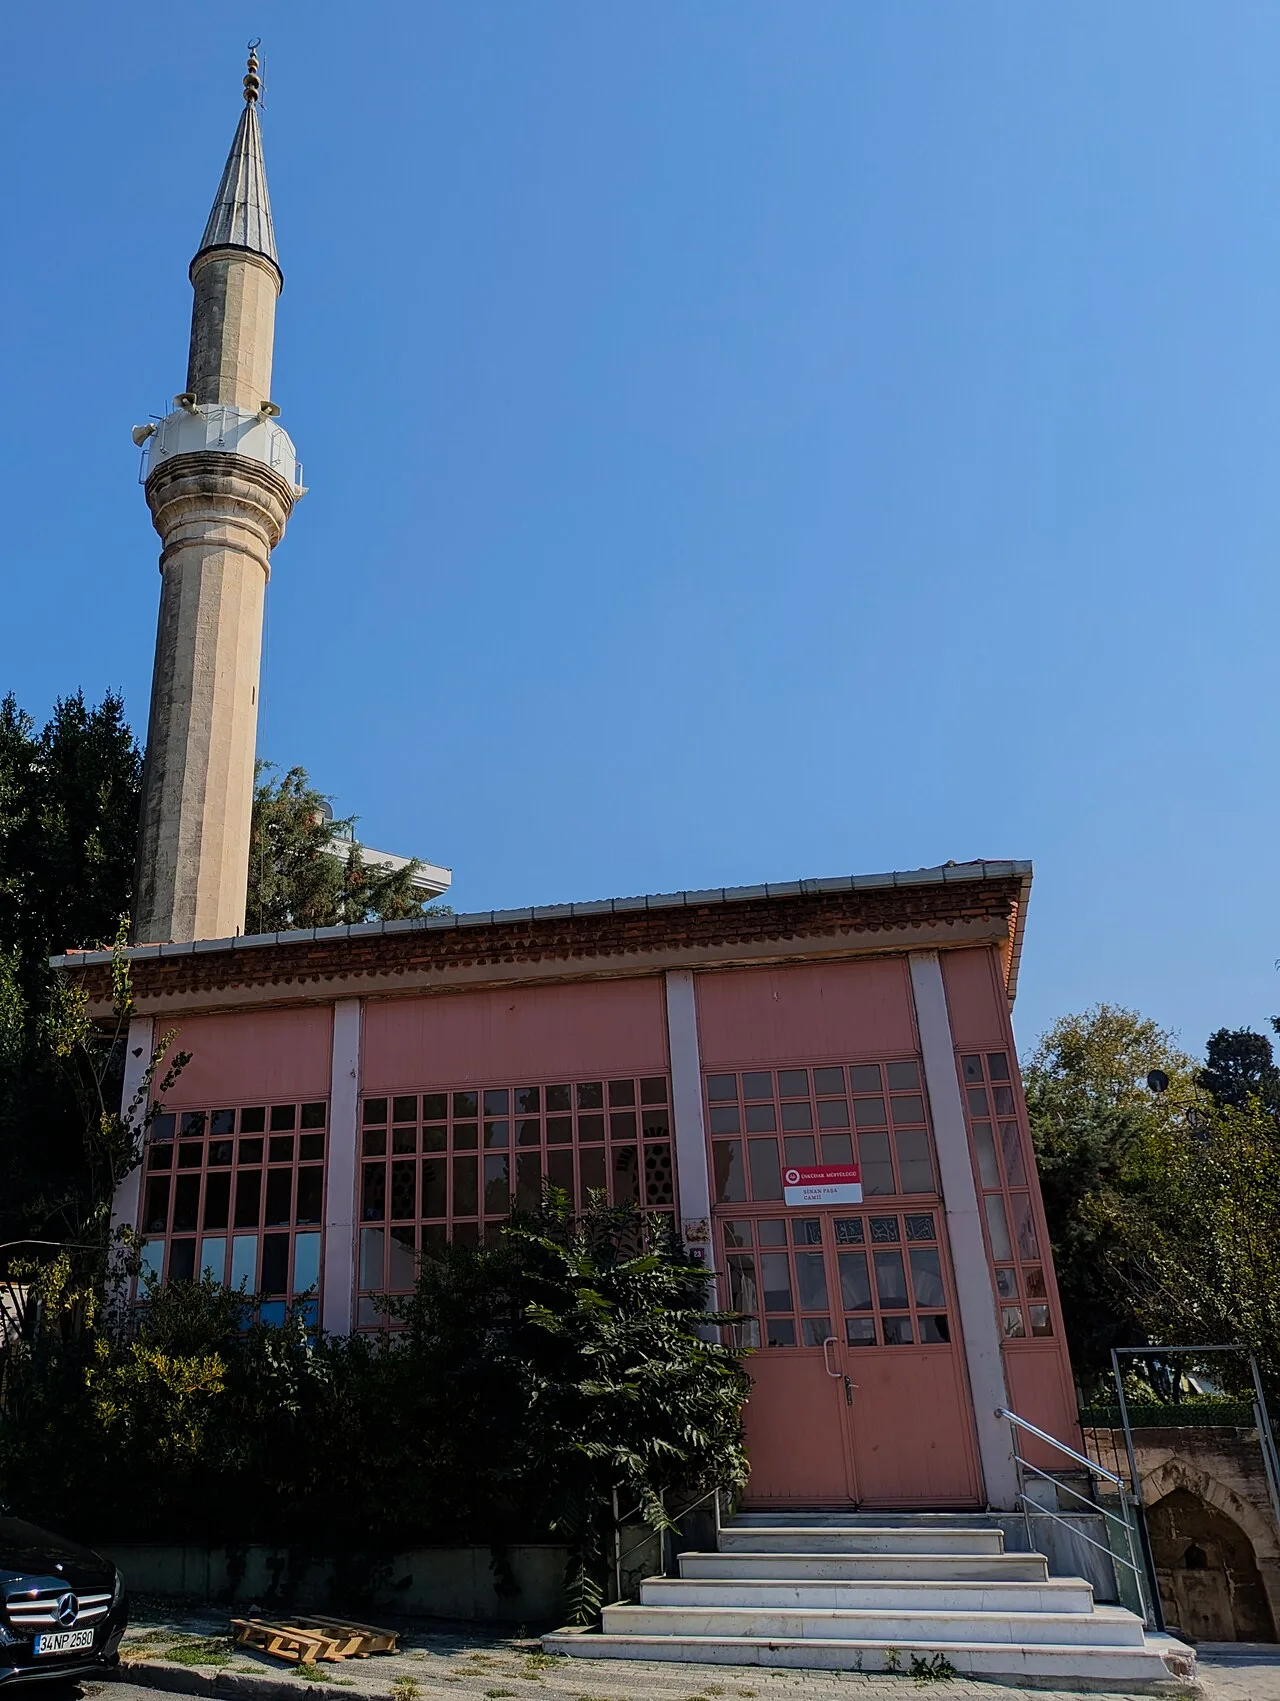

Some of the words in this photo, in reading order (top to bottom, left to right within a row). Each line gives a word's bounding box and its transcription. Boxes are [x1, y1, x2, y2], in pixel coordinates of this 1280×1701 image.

[694, 1250, 701, 1258] 23
[41, 1635, 53, 1651] 34
[54, 1634, 70, 1649] NP
[70, 1630, 93, 1647] 2580
